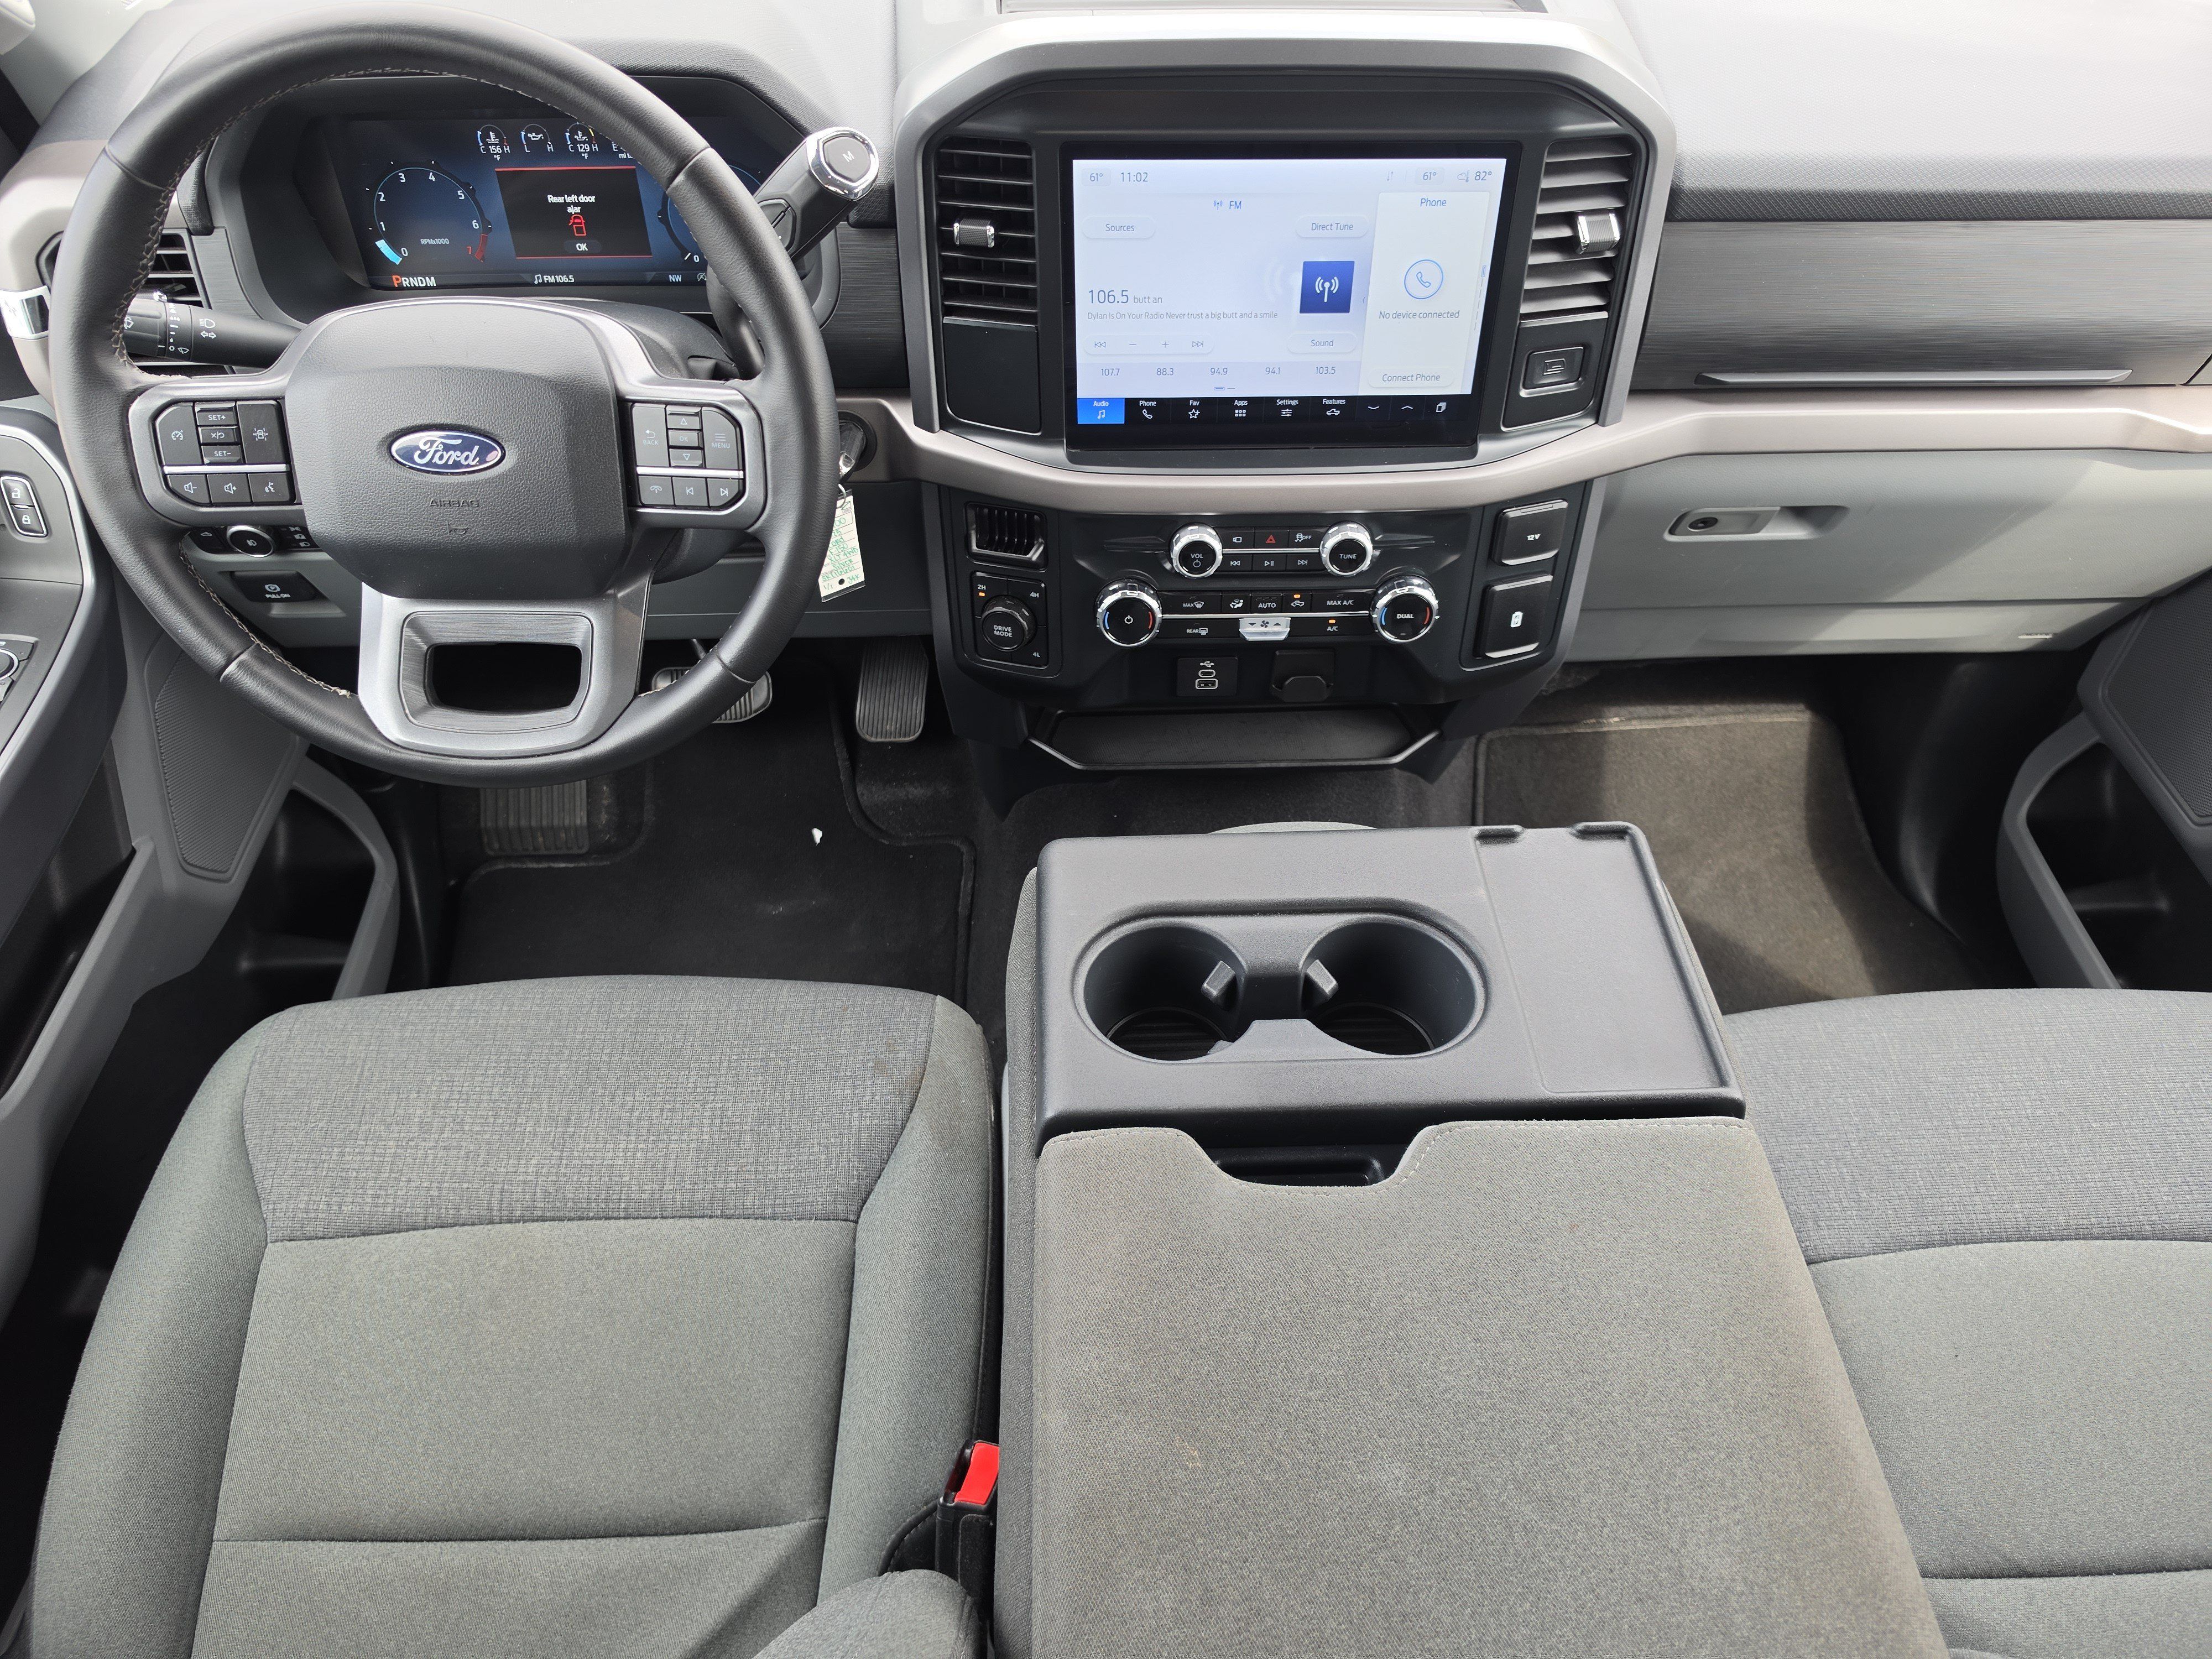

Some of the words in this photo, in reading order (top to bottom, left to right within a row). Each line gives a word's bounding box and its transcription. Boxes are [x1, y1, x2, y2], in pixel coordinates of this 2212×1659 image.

[489, 145, 502, 154] 156
[842, 150, 855, 163] M
[398, 173, 406, 182] 3
[429, 172, 436, 181] 4
[1089, 173, 1103, 182] 61°
[1121, 172, 1149, 182] 11:02
[1423, 172, 1436, 181] 61°
[1474, 171, 1492, 181] 82°
[378, 192, 386, 202] 2
[457, 190, 465, 200] 5
[547, 195, 564, 203] Rear
[565, 194, 578, 202] left
[578, 194, 596, 202] door
[1229, 201, 1241, 210] FM
[1420, 197, 1447, 207] Phone
[567, 205, 581, 214] ajar
[380, 222, 385, 231] 1
[472, 220, 479, 229] 6
[1105, 223, 1134, 232] Sources
[1311, 222, 1333, 231] Direct
[1335, 222, 1353, 231] Tune
[576, 243, 588, 251] OK
[401, 247, 408, 257] 0
[543, 275, 555, 283] FM
[1088, 290, 1129, 304] 106.5
[1134, 295, 1150, 304] butt
[1087, 312, 1107, 321] Dylan
[1211, 311, 1221, 321] big
[1391, 311, 1417, 319] device
[1418, 310, 1460, 319] connected
[1382, 374, 1413, 382] Connect
[414, 437, 480, 466] Ford
[429, 499, 479, 508] AIRBAG
